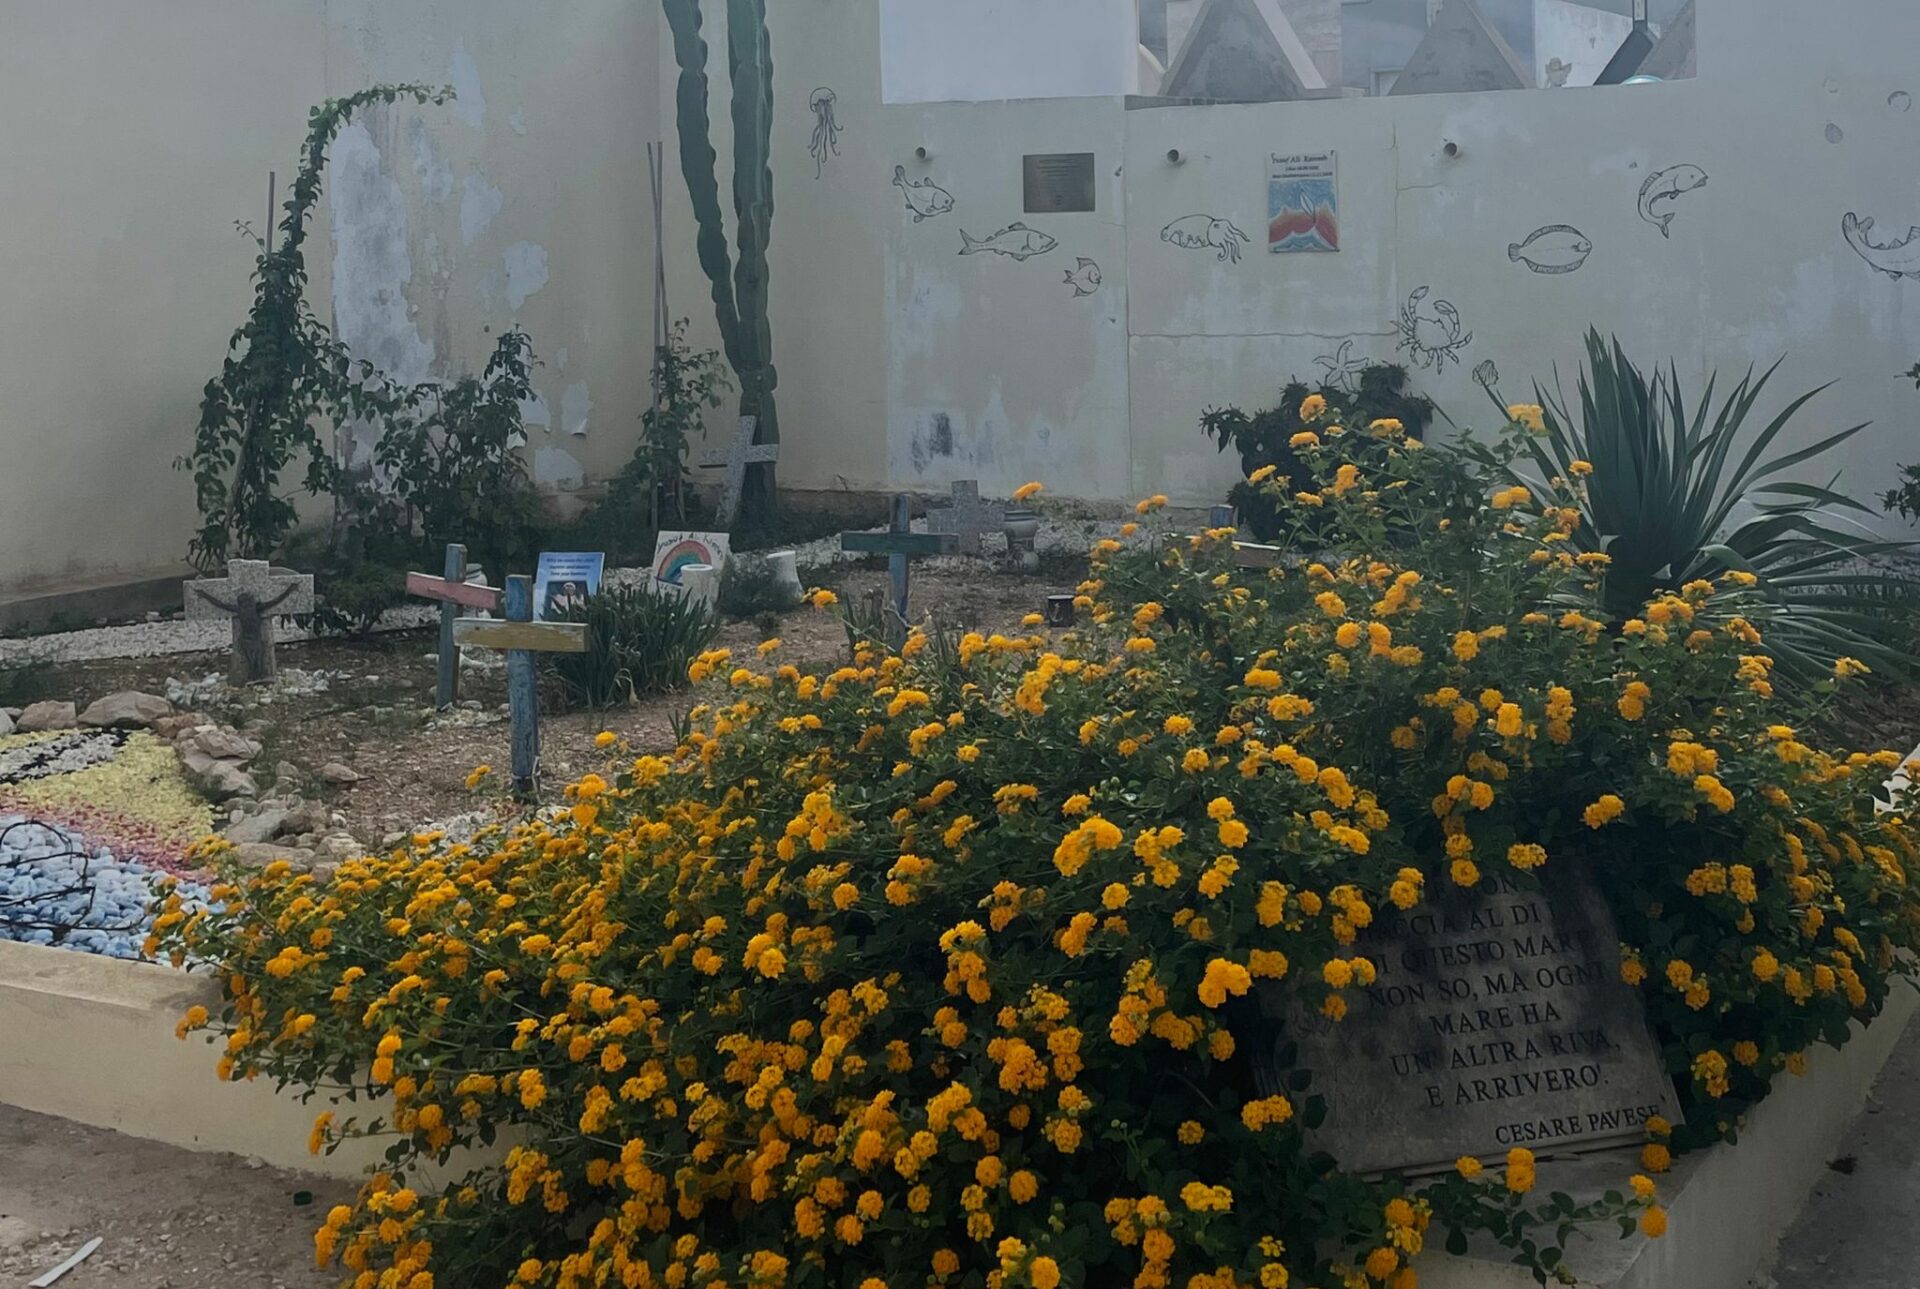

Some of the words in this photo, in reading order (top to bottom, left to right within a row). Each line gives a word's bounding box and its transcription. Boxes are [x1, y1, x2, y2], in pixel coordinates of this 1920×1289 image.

[1469, 907, 1505, 930] AL
[1511, 903, 1543, 926] DI
[1401, 940, 1505, 975] QUESTO
[1366, 982, 1426, 1009] NON
[1438, 977, 1478, 1001] SO,
[1483, 971, 1530, 996] MA
[1536, 961, 1606, 989] OGNI
[1430, 1006, 1513, 1037] MARE
[1519, 1002, 1563, 1024] HA
[1449, 1037, 1544, 1071] ALTRA
[1550, 1028, 1621, 1057] RIVA,
[1424, 1085, 1446, 1108] E
[1495, 1115, 1583, 1145] CESARE
[1586, 1104, 1661, 1133] PAVESE
